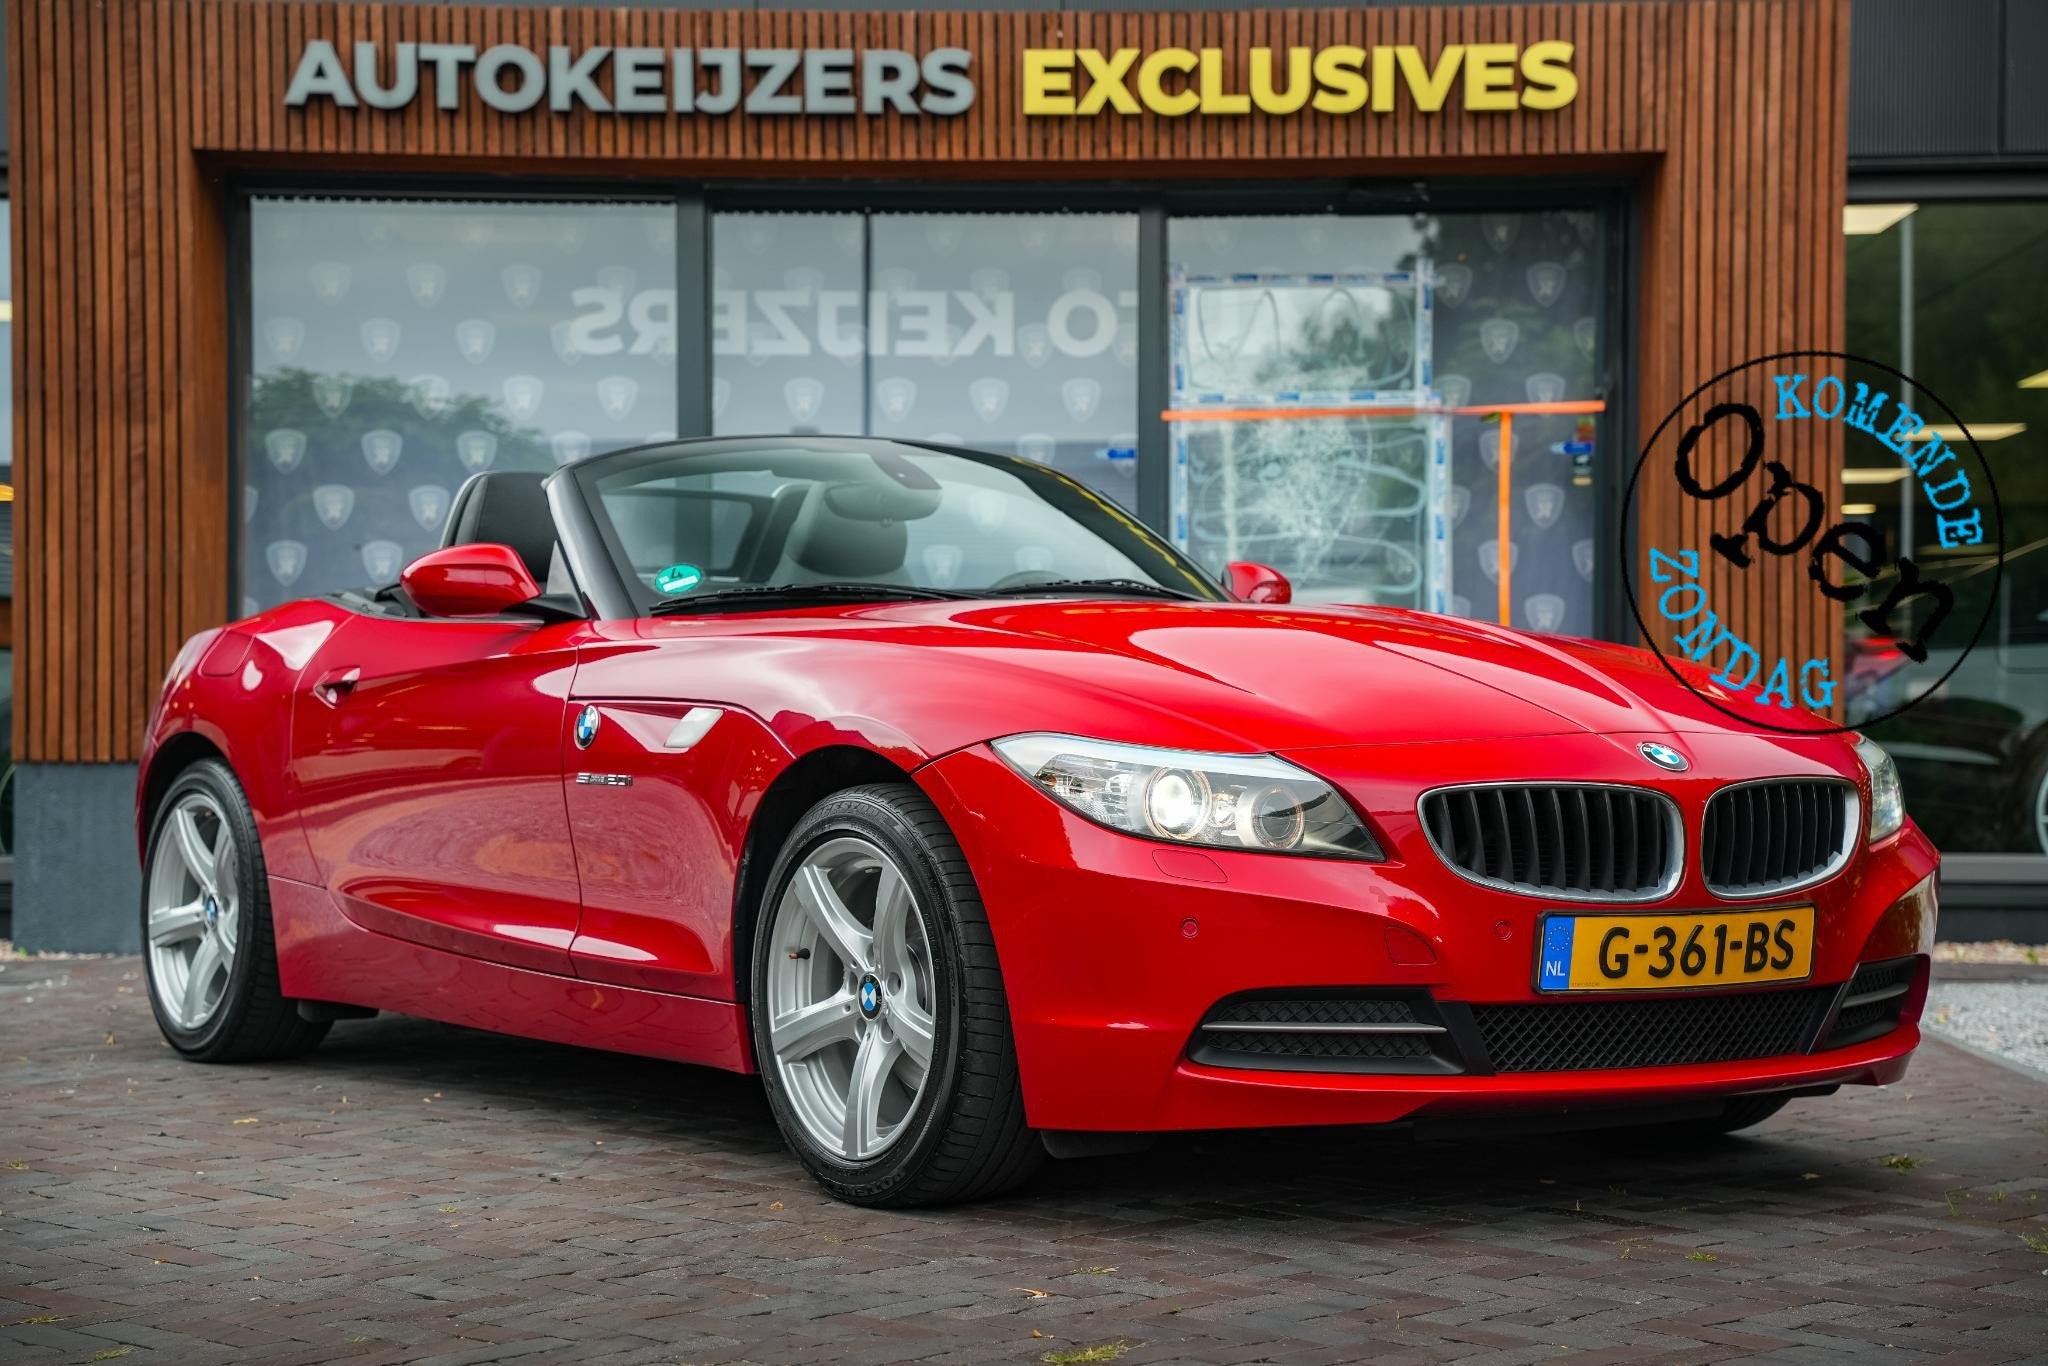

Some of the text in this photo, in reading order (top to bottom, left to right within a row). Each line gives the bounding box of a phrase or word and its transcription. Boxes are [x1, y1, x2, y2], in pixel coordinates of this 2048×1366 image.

[284, 40, 1578, 116] AUTOKEIJZERS EXCLUSIVES
[1545, 960, 1566, 977] NL
[1598, 918, 1796, 979] G-361-BS
